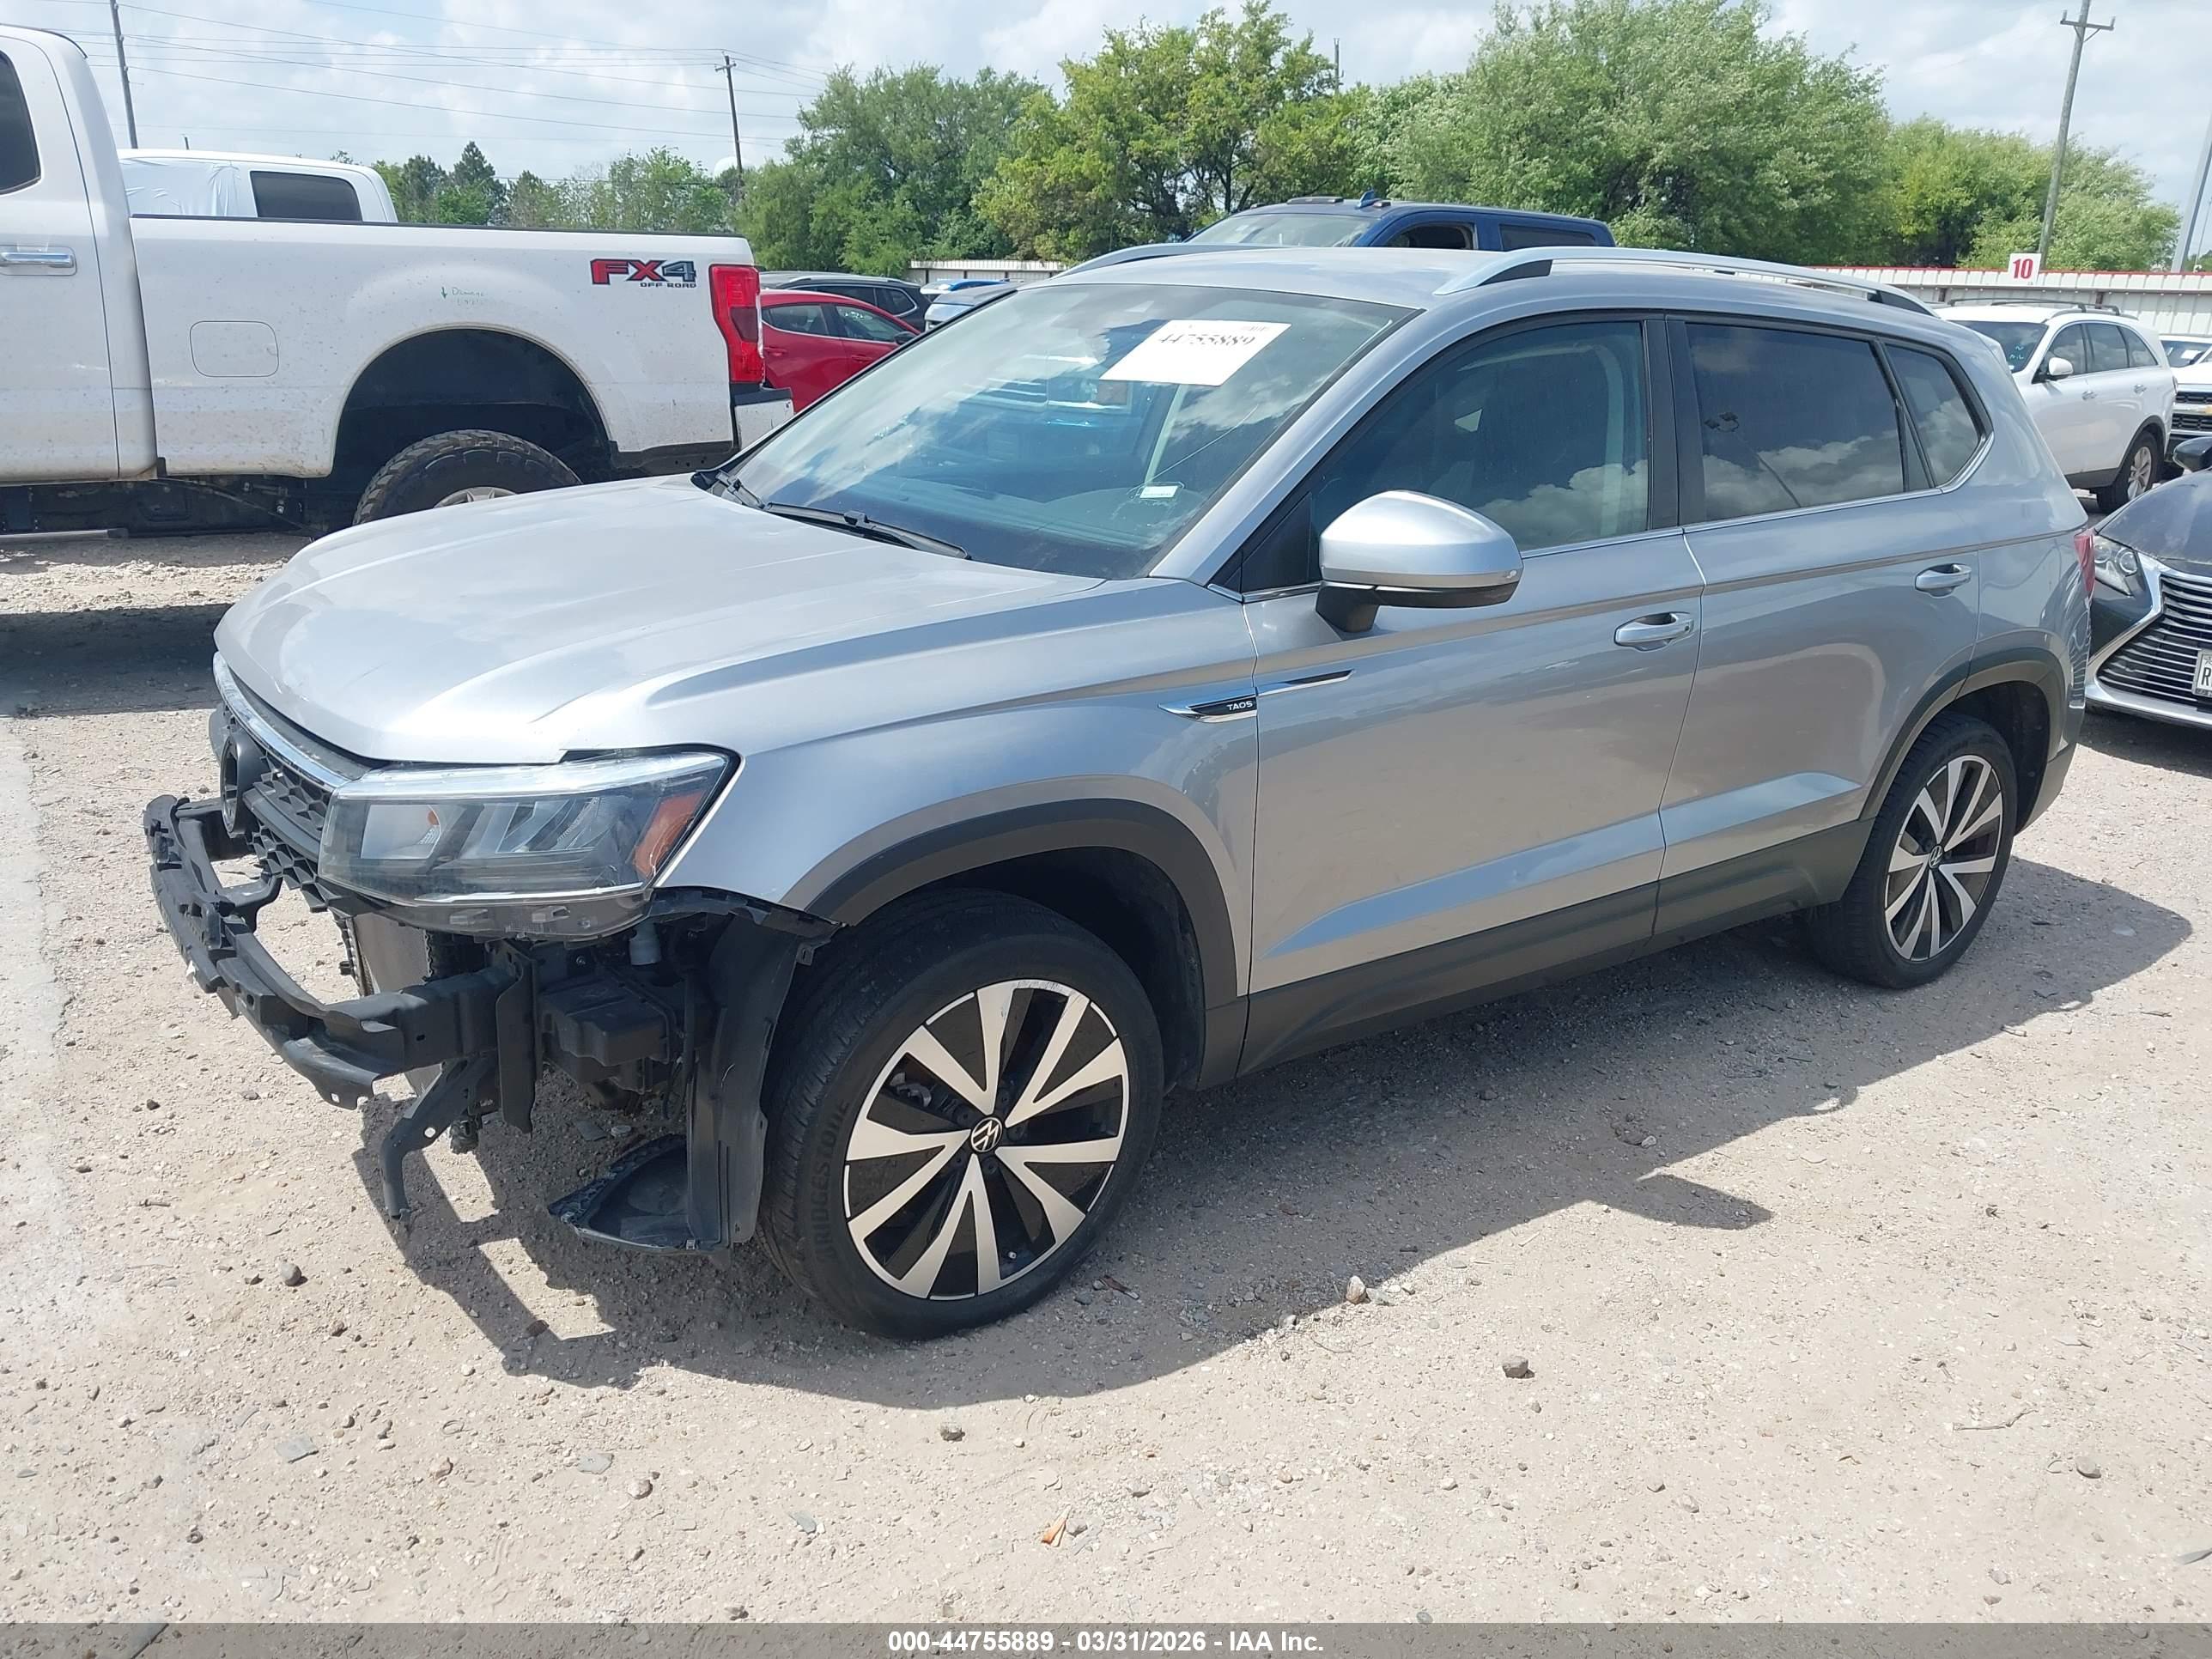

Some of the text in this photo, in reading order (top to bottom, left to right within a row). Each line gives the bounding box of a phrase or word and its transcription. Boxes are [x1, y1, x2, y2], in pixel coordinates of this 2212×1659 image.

[590, 258, 697, 285] FX4
[2013, 258, 2033, 279] 10
[1226, 701, 1253, 711] TAOS
